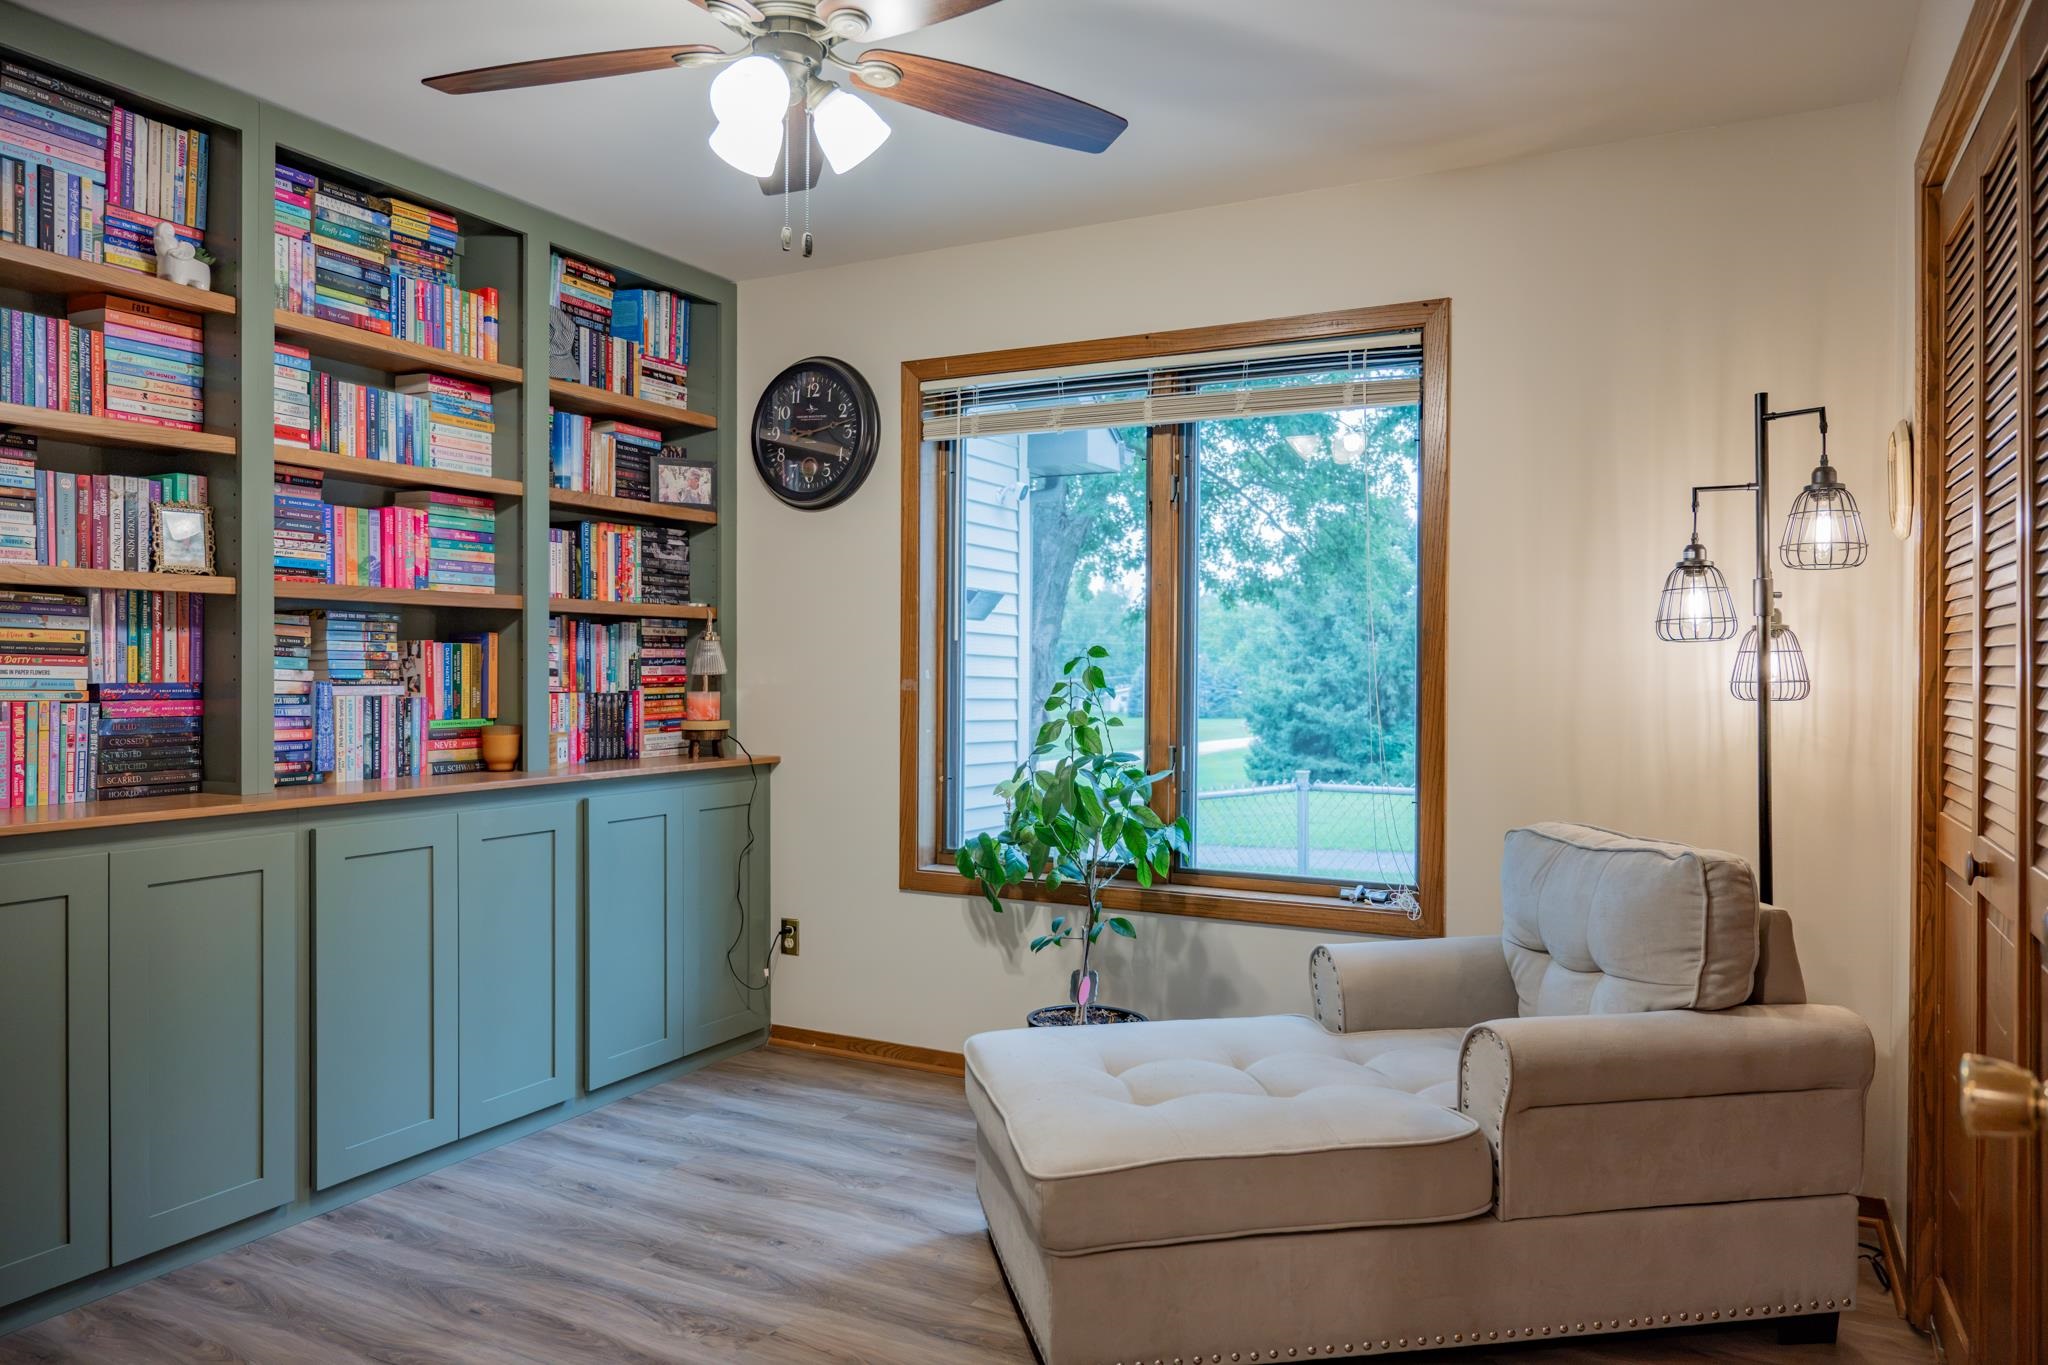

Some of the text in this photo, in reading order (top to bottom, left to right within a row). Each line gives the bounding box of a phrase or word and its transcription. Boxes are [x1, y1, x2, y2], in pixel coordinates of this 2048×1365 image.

[177, 134, 185, 168] BOSSMAN
[321, 224, 351, 238] Firefly Lane
[71, 343, 79, 353] ME
[155, 371, 177, 380] MOMENT
[791, 388, 801, 404] 11
[806, 382, 821, 398] 12
[826, 388, 832, 402] 1
[778, 406, 791, 421] 10
[838, 403, 848, 418] 2
[771, 426, 781, 441] 9
[777, 447, 786, 462] 8
[822, 462, 832, 477] 5
[113, 535, 121, 559] PRINCE
[4, 656, 31, 664] DOTTY
[282, 696, 300, 704] YARROS
[14, 717, 24, 739] WRONG
[109, 737, 144, 746] CROSSED
[433, 740, 458, 749] NEVER
[14, 739, 25, 761] NUMBER
[107, 762, 148, 771] WRETCHED
[107, 775, 141, 785] SCARRED
[108, 790, 138, 798] HOOKED
